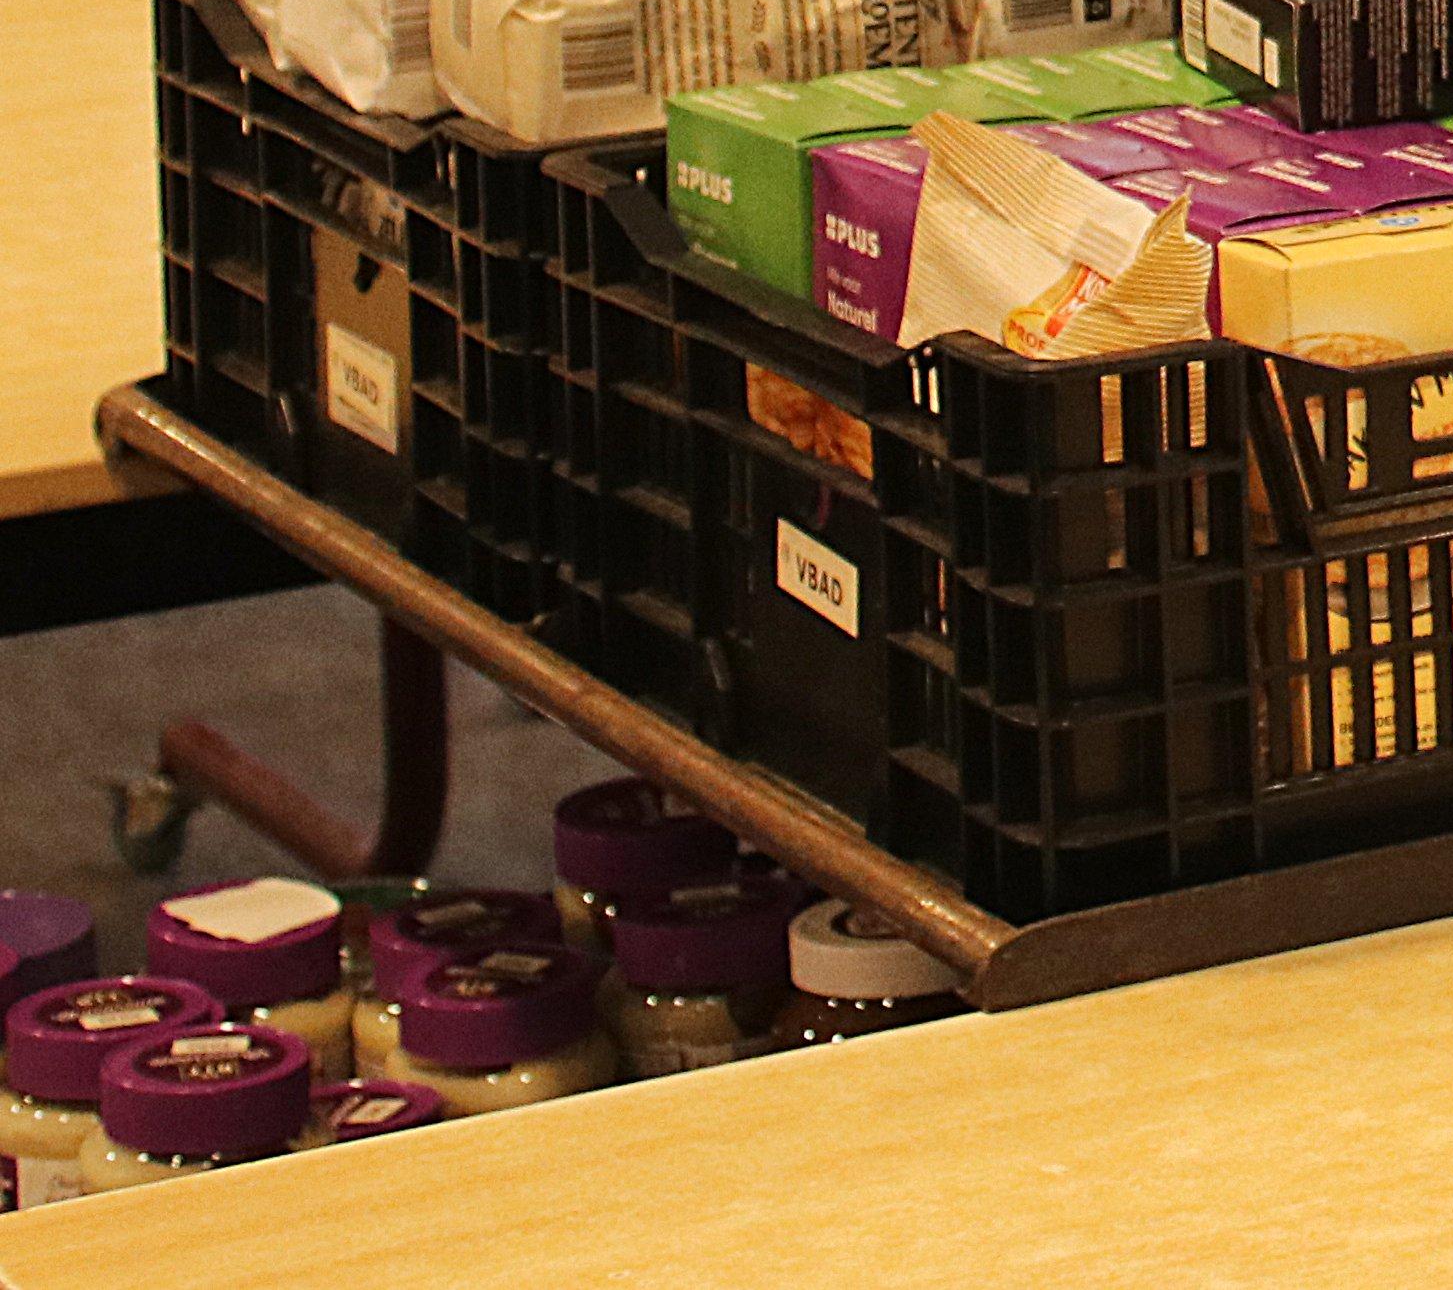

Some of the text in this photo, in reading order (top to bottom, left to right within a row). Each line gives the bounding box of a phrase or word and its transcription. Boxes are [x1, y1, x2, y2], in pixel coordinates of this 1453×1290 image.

[688, 163, 734, 205] PLUS
[836, 216, 882, 260] PLUS
[827, 290, 880, 335] Naturel
[795, 552, 843, 607] VBAD
